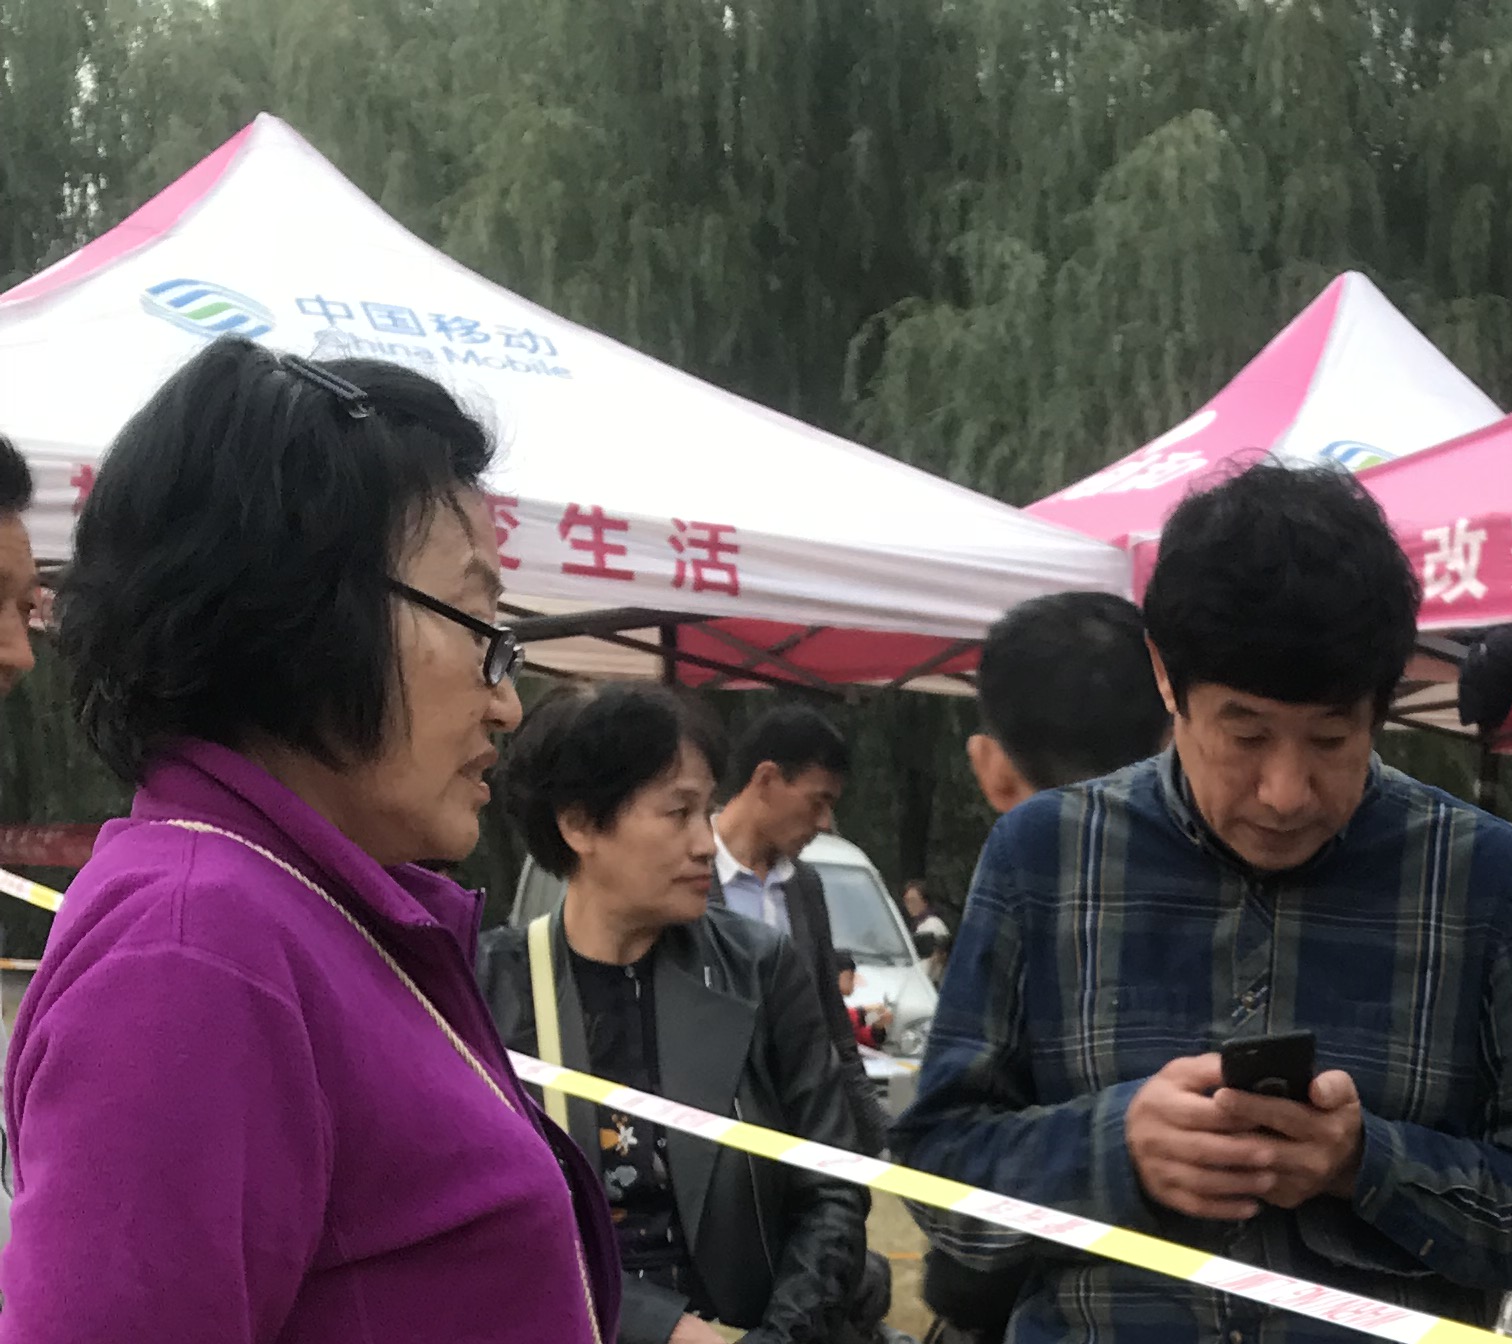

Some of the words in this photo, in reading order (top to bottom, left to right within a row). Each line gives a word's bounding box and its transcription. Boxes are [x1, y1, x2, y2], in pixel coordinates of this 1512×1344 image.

[296, 295, 558, 356] 中国移动
[442, 346, 572, 379] Mobile
